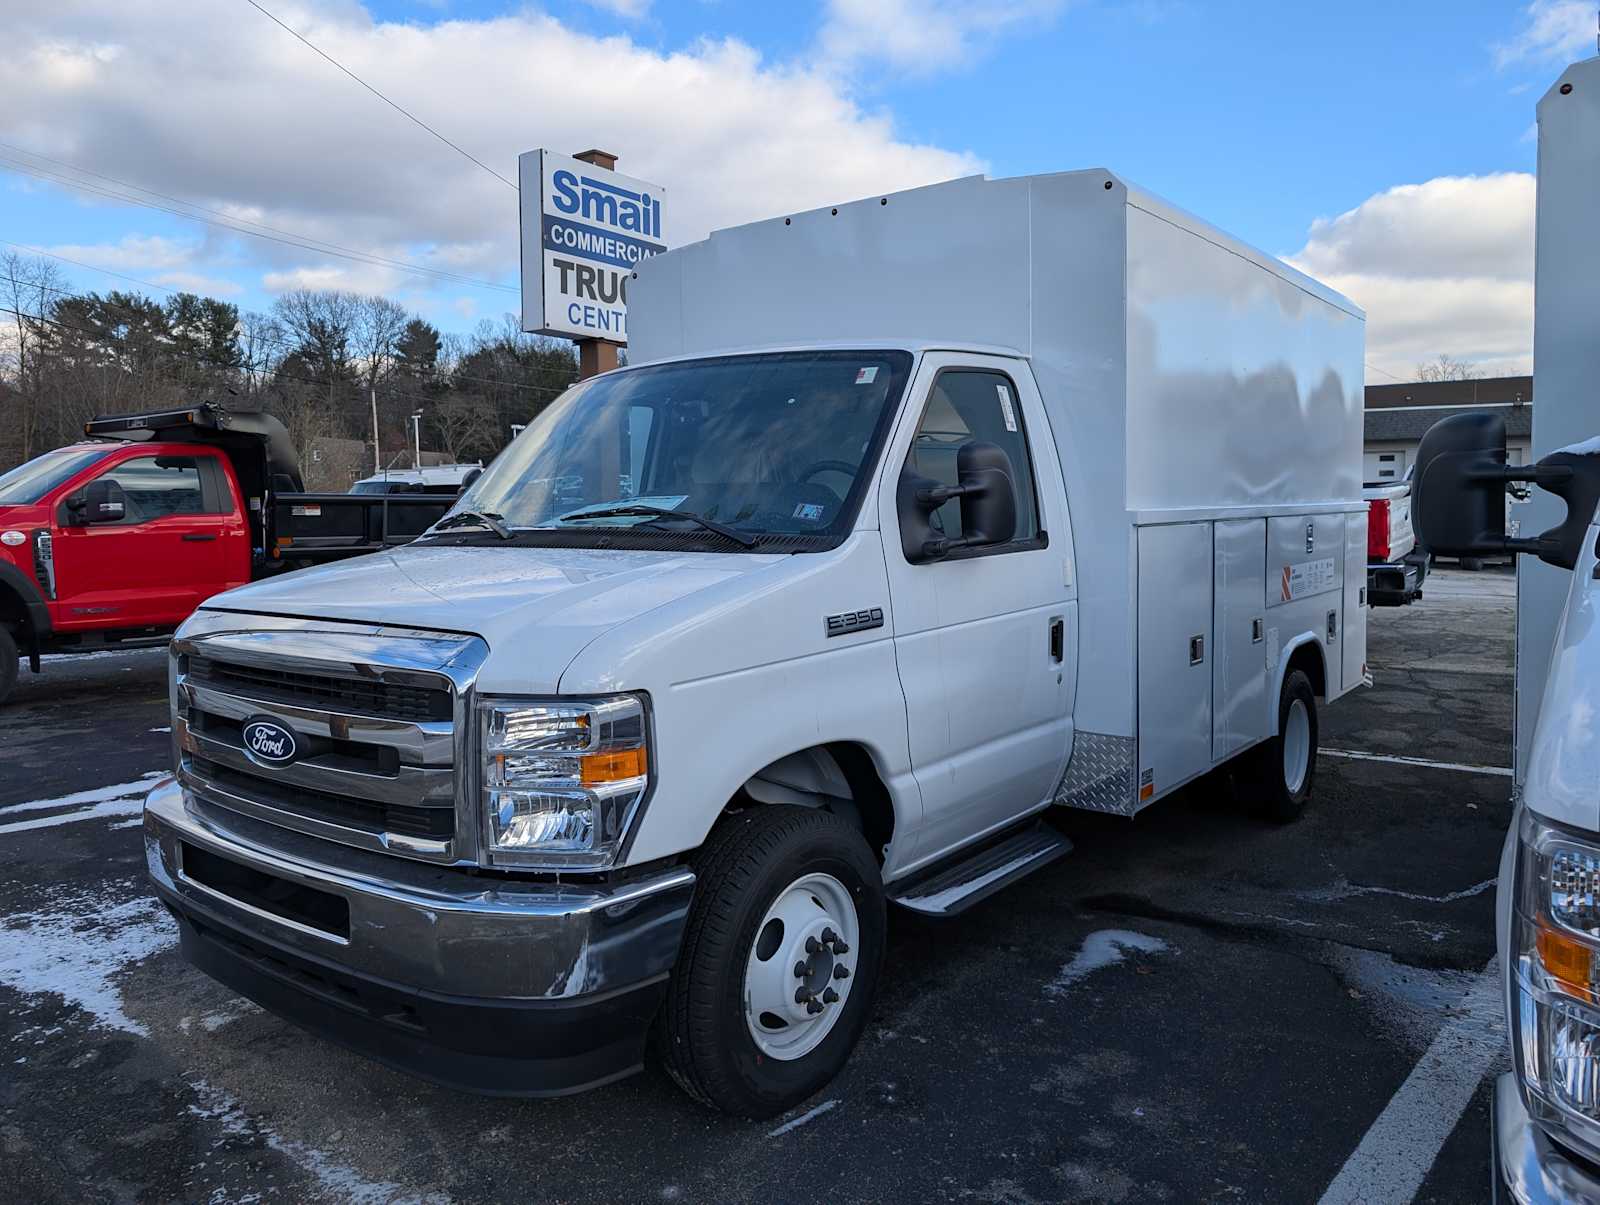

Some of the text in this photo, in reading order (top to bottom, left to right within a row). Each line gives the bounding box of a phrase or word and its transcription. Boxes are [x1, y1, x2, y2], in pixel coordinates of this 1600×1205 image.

[552, 169, 661, 240] Smail
[551, 224, 657, 262] COMMERCIA
[568, 302, 628, 333] CENT
[252, 726, 285, 756] Ford
